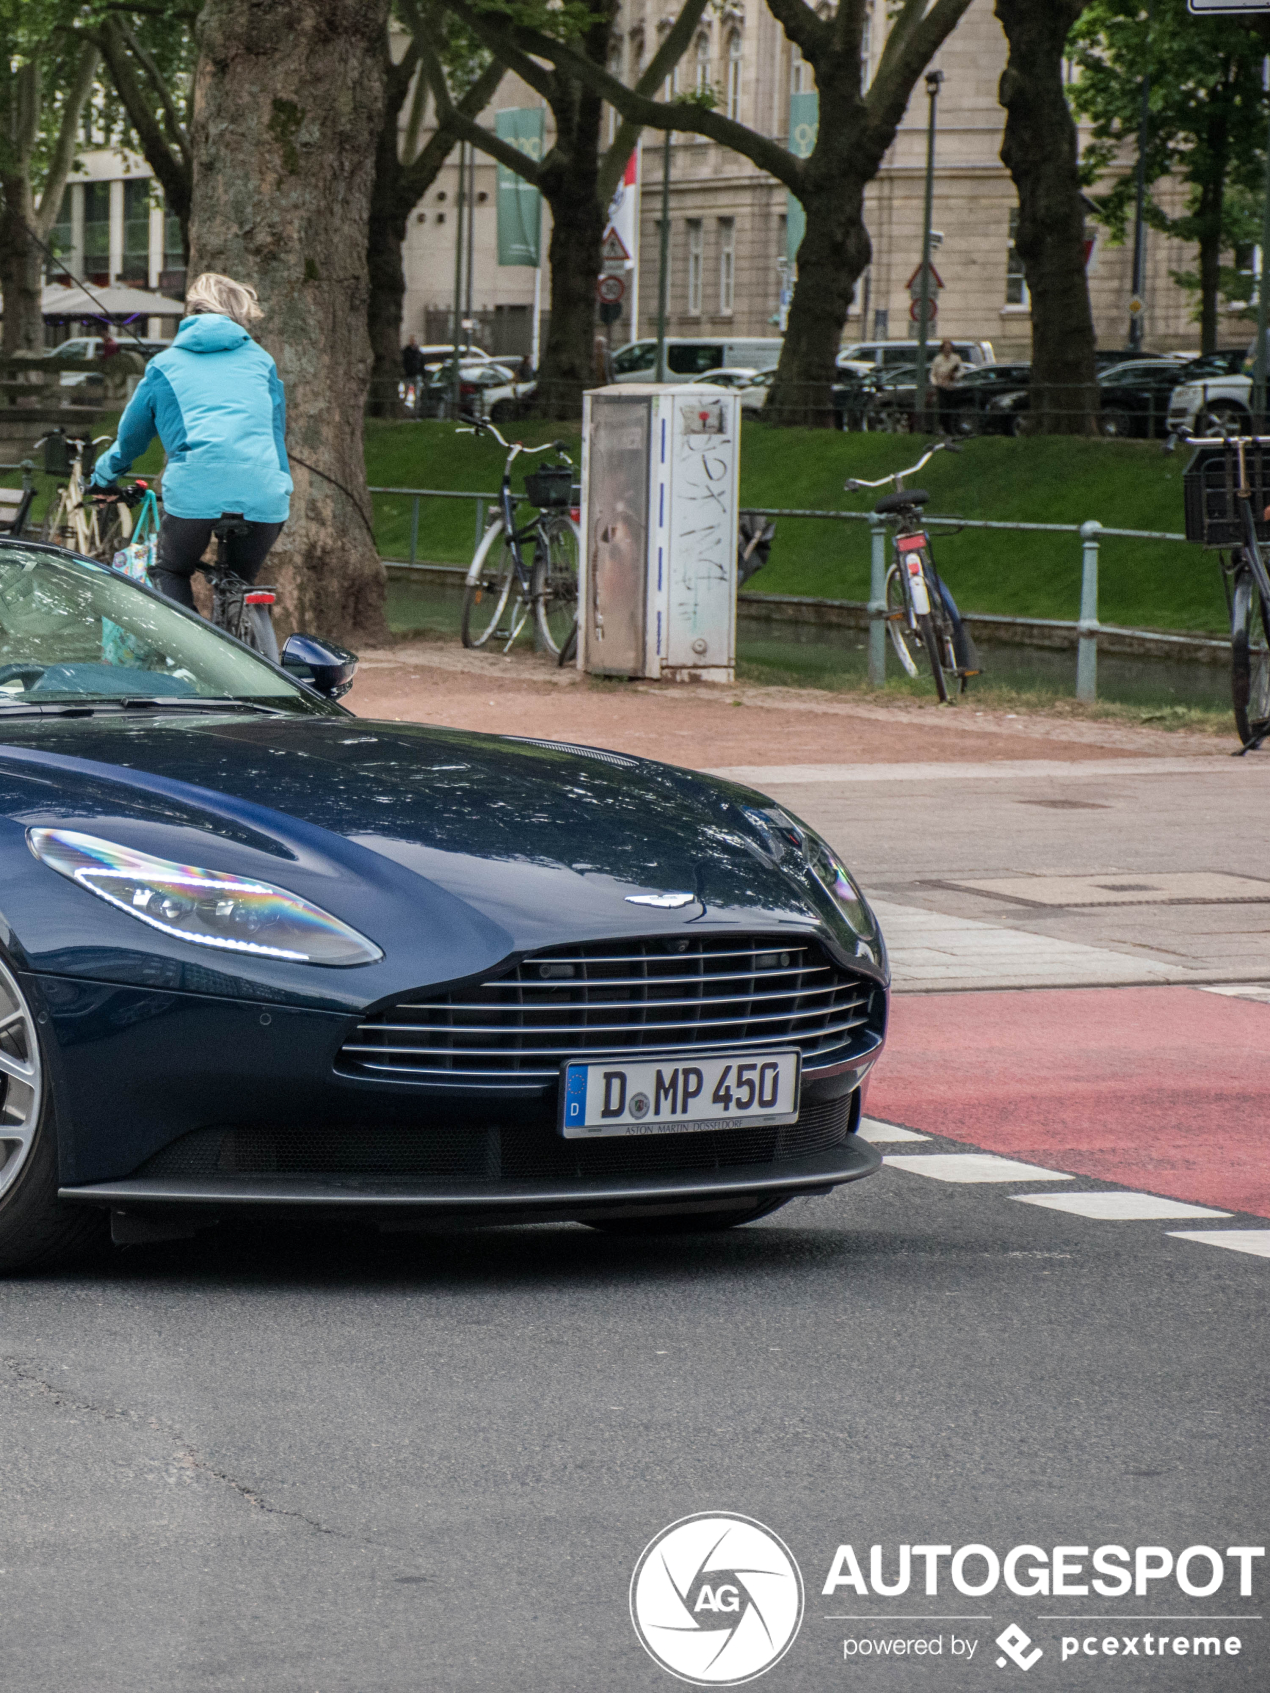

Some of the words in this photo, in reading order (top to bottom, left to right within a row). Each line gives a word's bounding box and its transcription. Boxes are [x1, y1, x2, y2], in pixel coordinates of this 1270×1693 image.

[601, 1070, 628, 1119] D
[654, 1066, 704, 1116] MP
[712, 1061, 780, 1112] 450
[570, 1102, 580, 1117] D
[625, 1126, 654, 1136] ASTON
[657, 1122, 689, 1134] MARTIN
